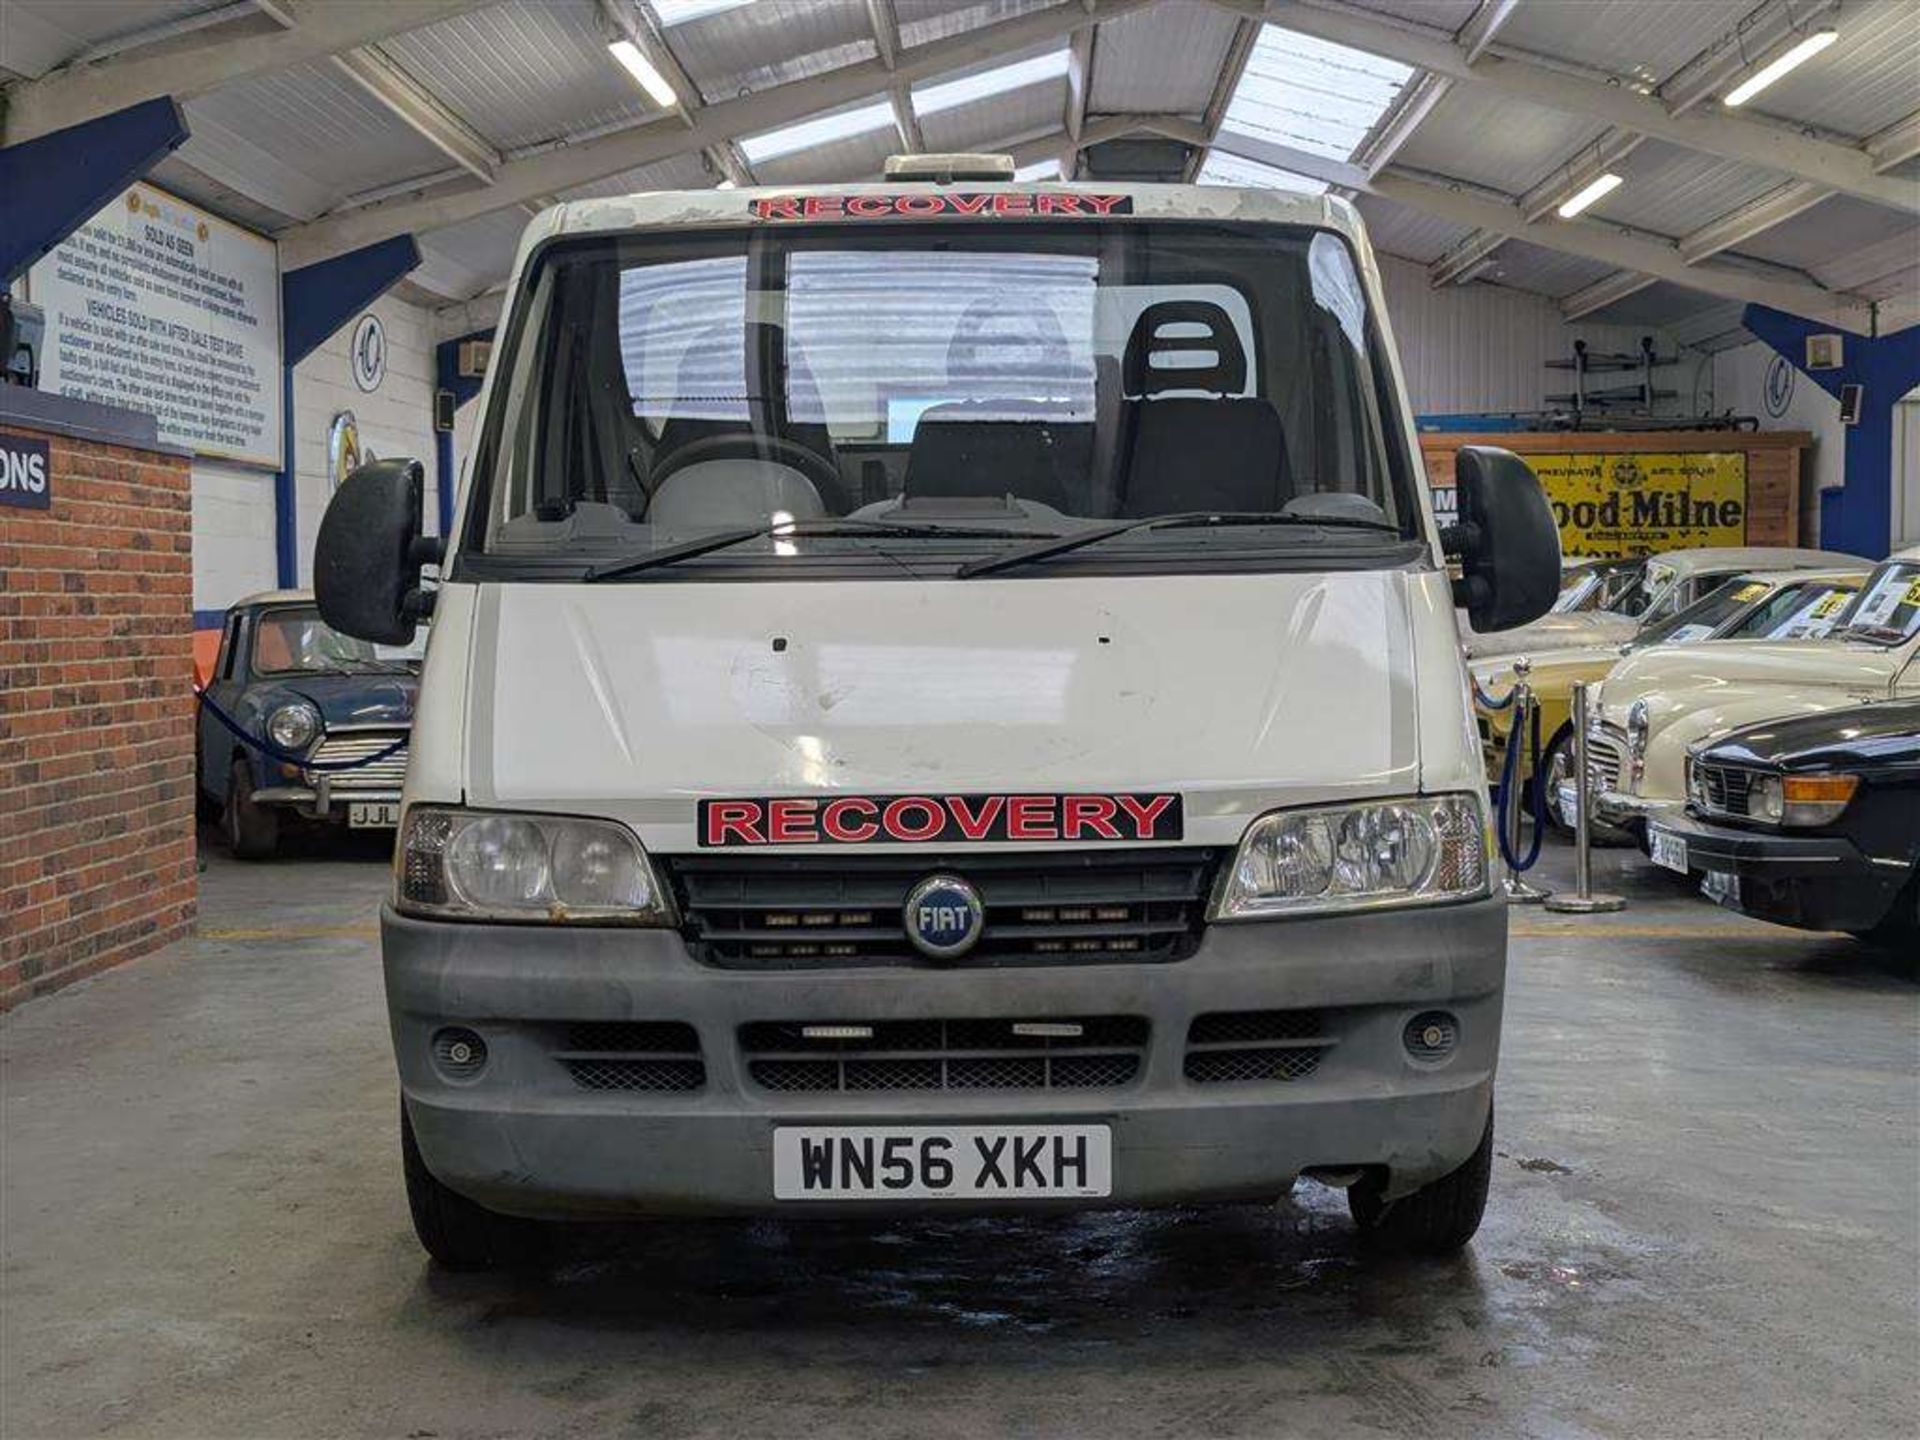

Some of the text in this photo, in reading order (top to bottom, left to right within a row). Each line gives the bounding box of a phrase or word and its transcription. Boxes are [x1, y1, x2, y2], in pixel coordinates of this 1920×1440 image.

[755, 194, 1127, 219] RECOVERY
[144, 224, 193, 257] SOLD AS SEEN
[87, 299, 242, 359] VEHICLES SOLD WITH AFTER SALE TEST DRIVE
[1548, 488, 1742, 530] ood-Milne
[707, 795, 1175, 844] RECOVERY
[920, 906, 968, 932] FIAT
[801, 1136, 1087, 1190] WN56 XKH
